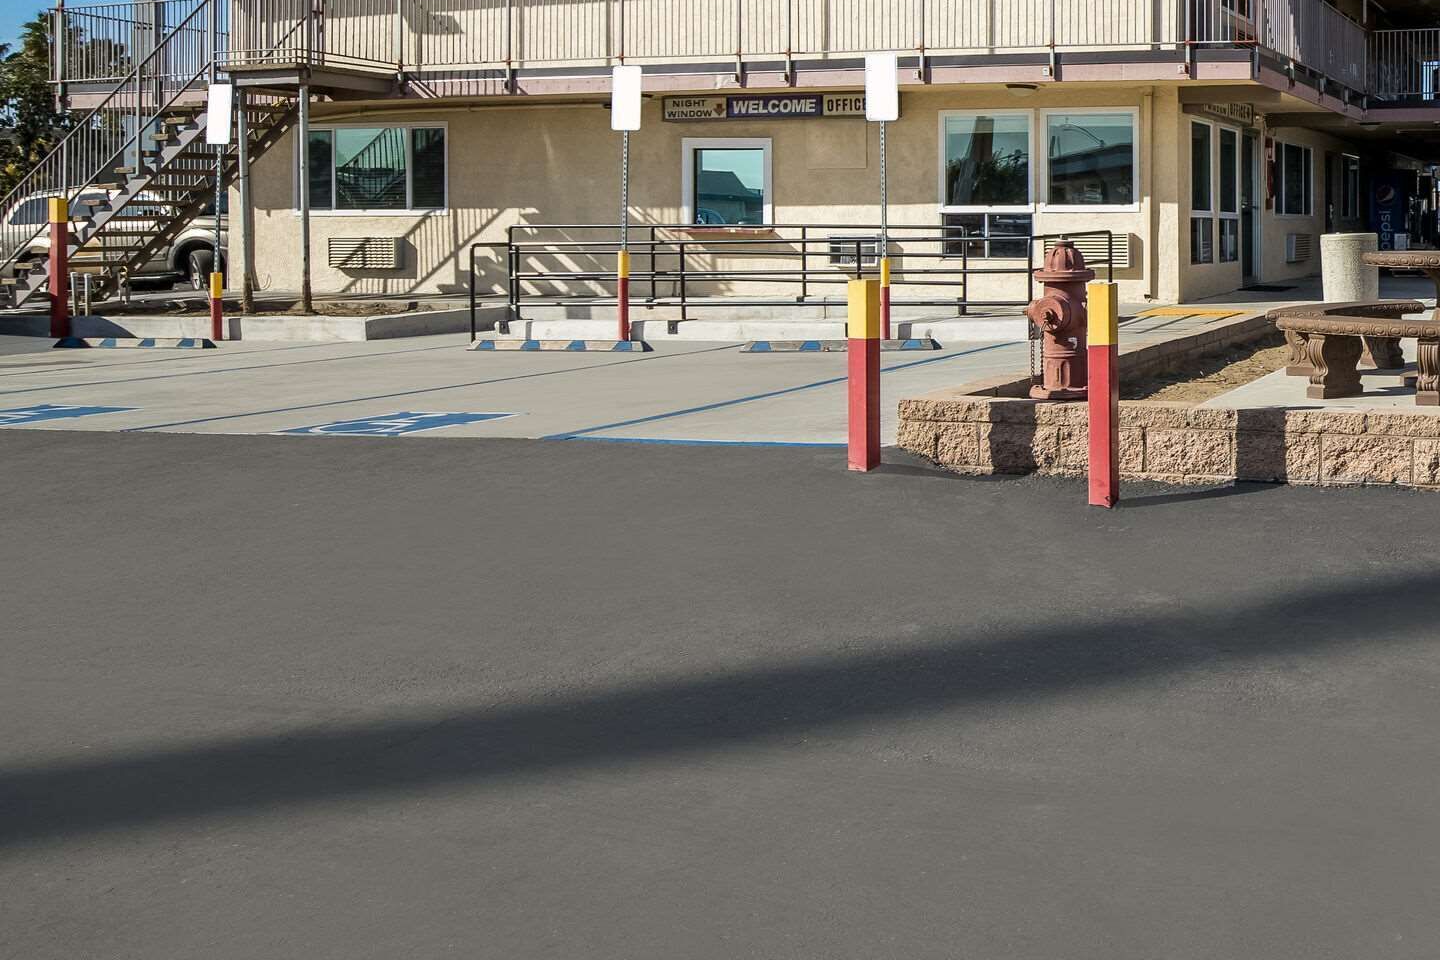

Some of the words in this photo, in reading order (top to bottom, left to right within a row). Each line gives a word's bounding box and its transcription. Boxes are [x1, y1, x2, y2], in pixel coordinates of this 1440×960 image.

[672, 99, 707, 108] NIGHT
[732, 98, 817, 115] WELCOME
[667, 109, 713, 119] WINDOW
